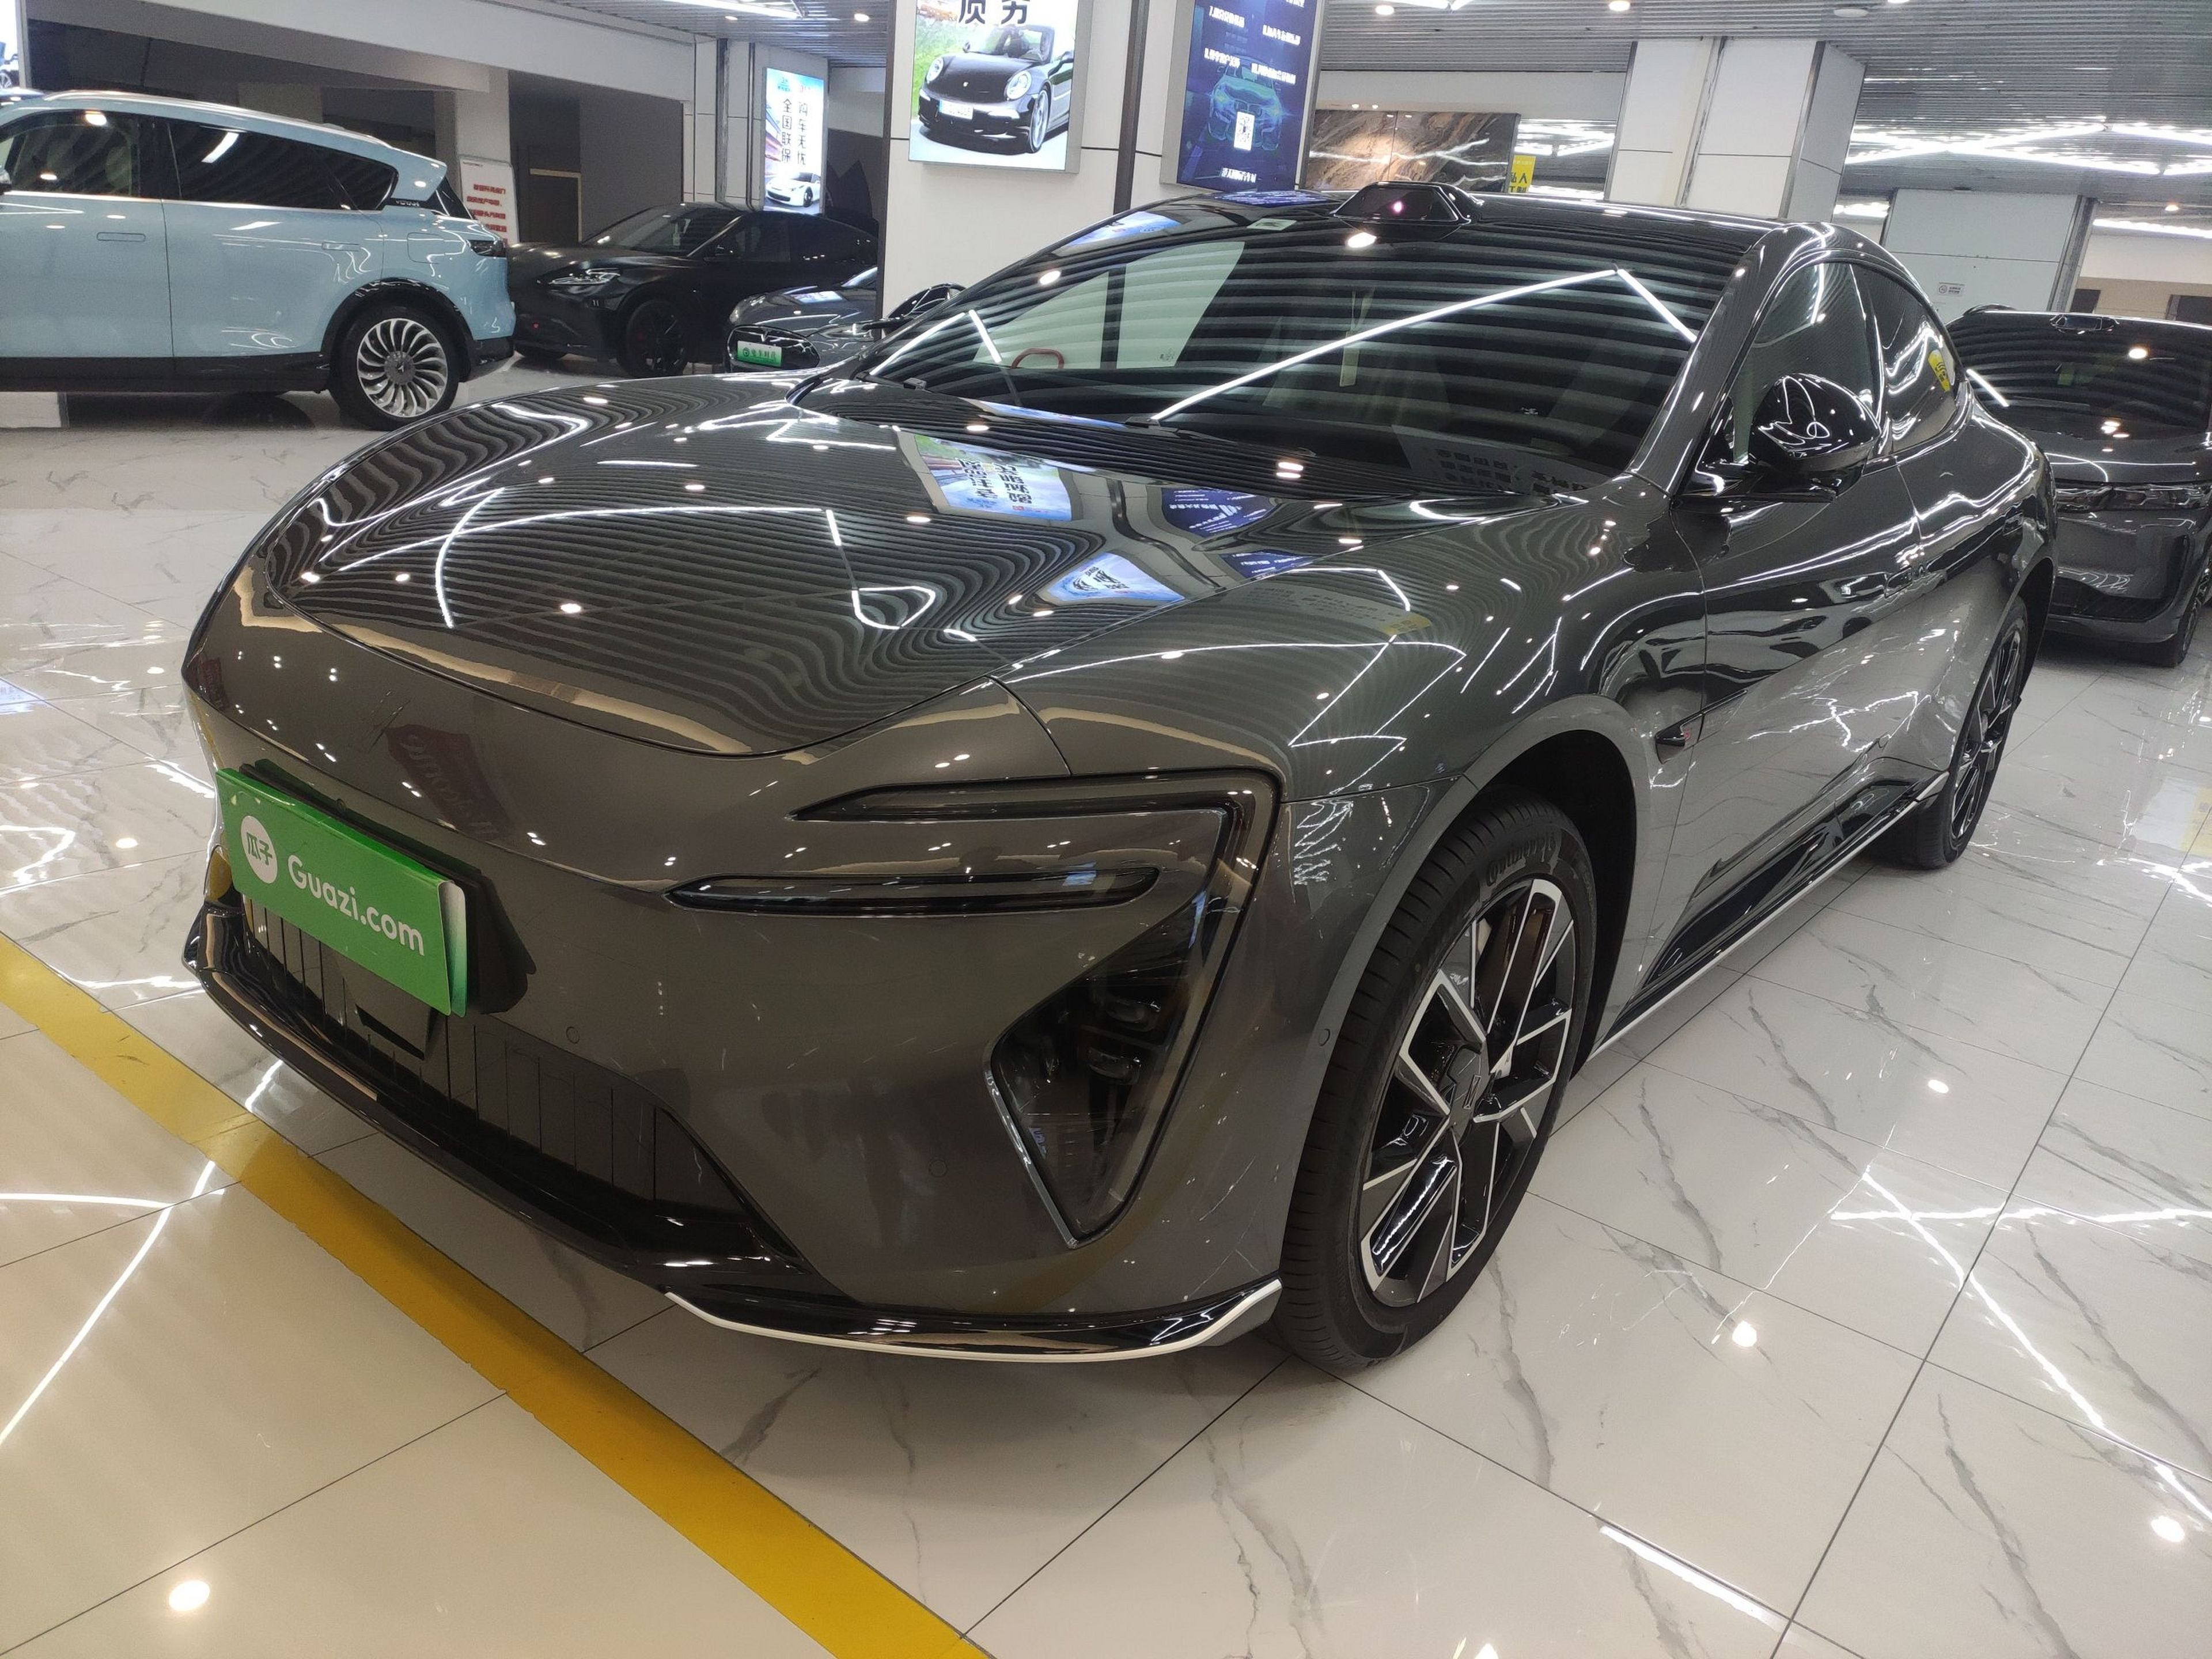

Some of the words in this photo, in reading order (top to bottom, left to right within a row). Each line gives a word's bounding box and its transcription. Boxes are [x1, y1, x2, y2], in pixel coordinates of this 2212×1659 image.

[781, 99, 792, 162] 全国联保
[797, 102, 808, 165] 购车无忧
[247, 832, 272, 865] 瓜子
[288, 855, 425, 956] Guazi.com
